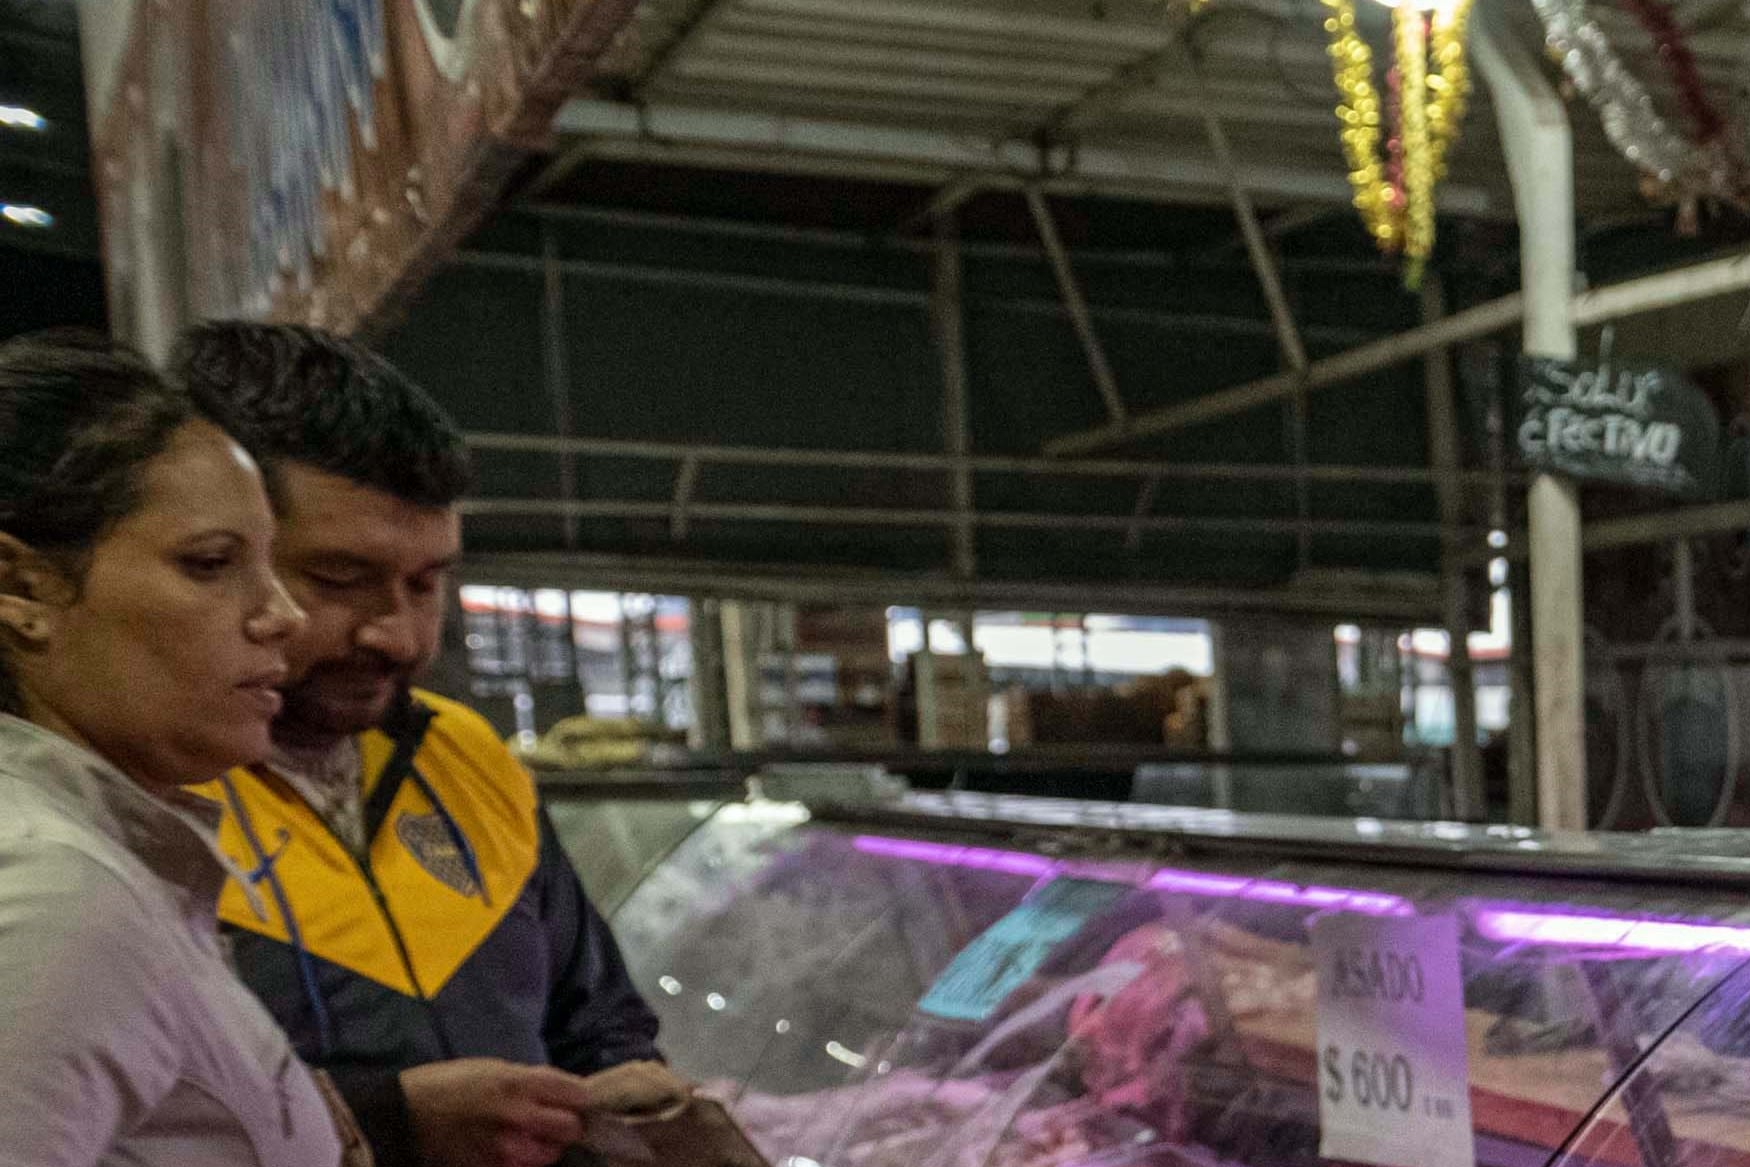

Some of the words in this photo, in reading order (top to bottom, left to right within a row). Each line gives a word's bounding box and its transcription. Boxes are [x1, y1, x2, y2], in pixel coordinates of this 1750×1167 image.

[1330, 950, 1424, 1002] ASADO
[1324, 1045, 1345, 1104] $
[1352, 1049, 1413, 1112] 600
